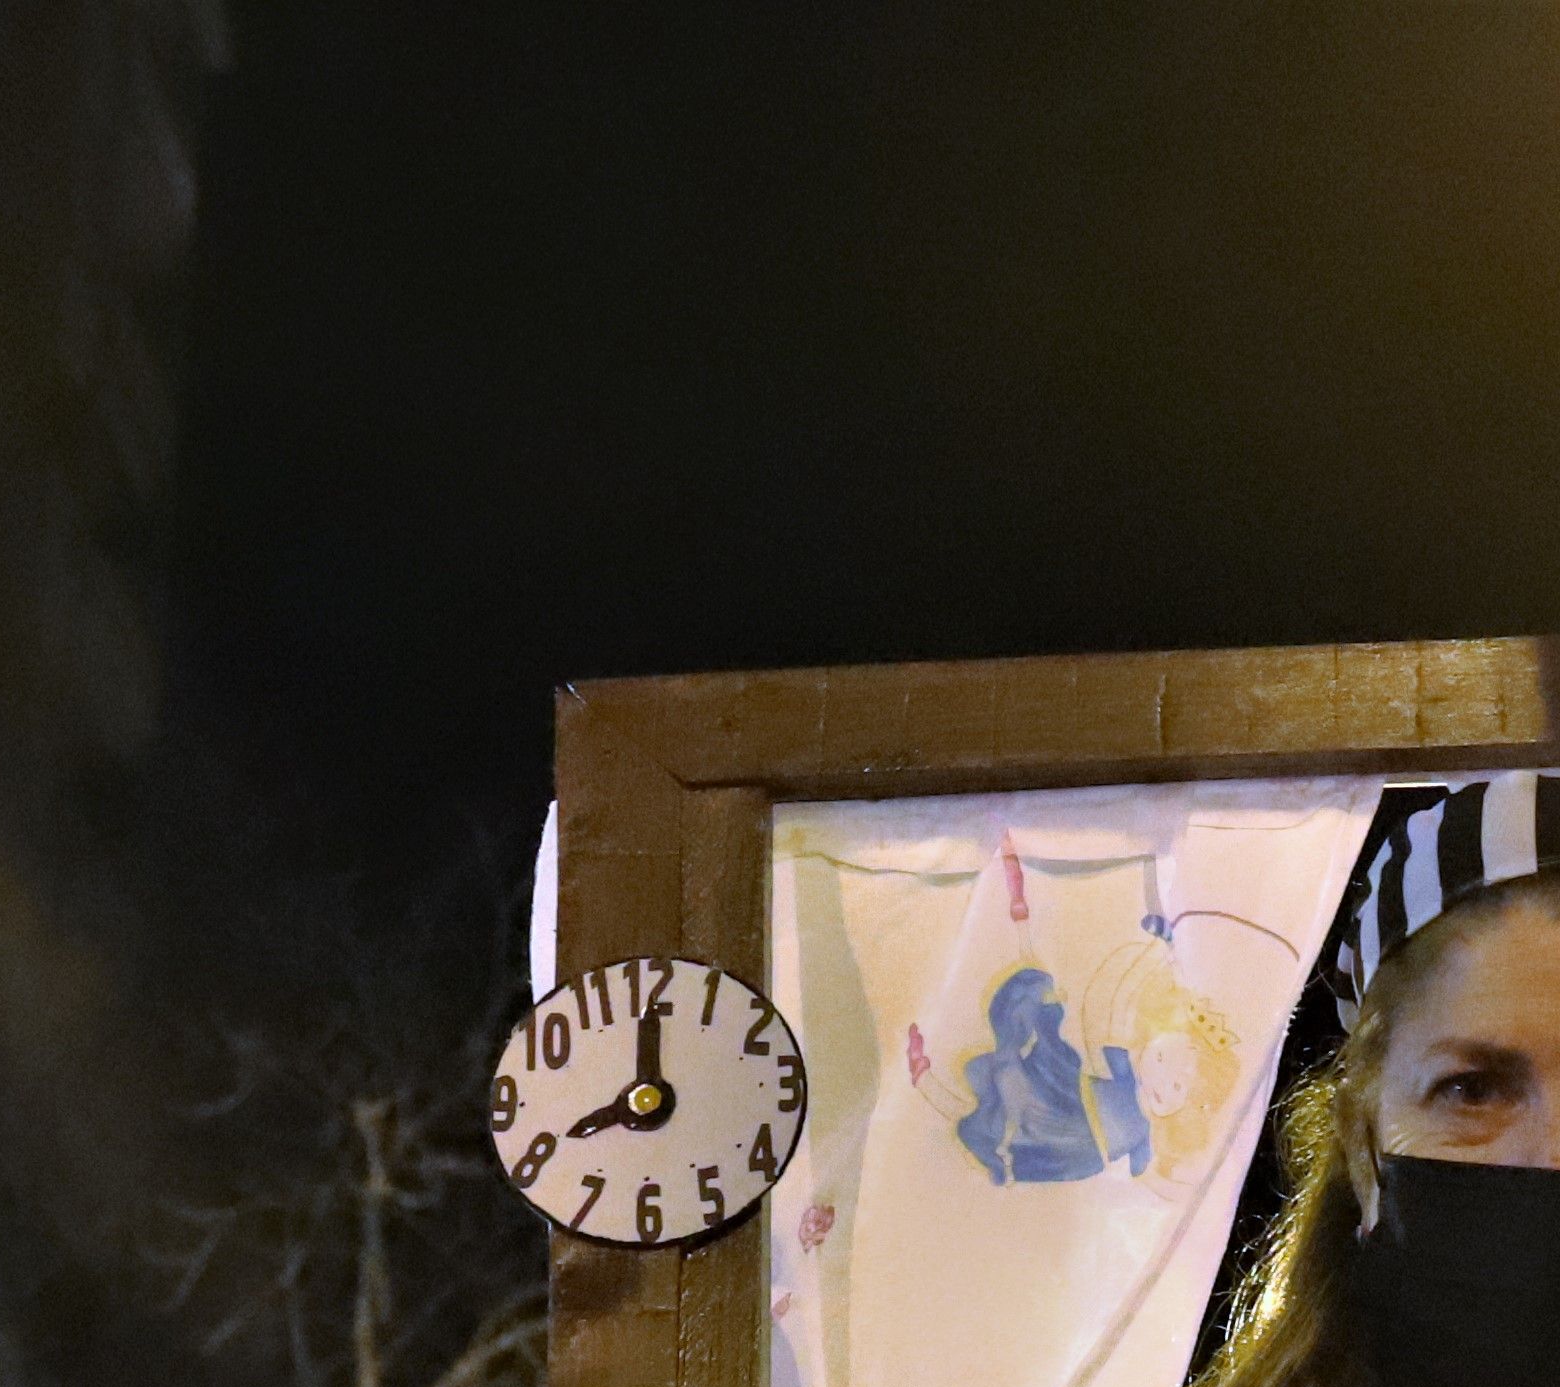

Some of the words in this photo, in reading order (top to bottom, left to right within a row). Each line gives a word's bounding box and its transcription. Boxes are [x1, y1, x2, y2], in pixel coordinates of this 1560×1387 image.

[569, 970, 614, 1029] 11
[623, 959, 673, 1018] 12
[701, 969, 722, 1025] 1
[520, 1007, 570, 1071] 10
[743, 998, 774, 1055] 2
[491, 1075, 518, 1131] 9
[777, 1056, 803, 1112] 3
[511, 1132, 557, 1188] 8
[748, 1123, 778, 1182] 4
[570, 1175, 606, 1230] 7
[636, 1184, 663, 1243] 6
[697, 1165, 725, 1225] 5
